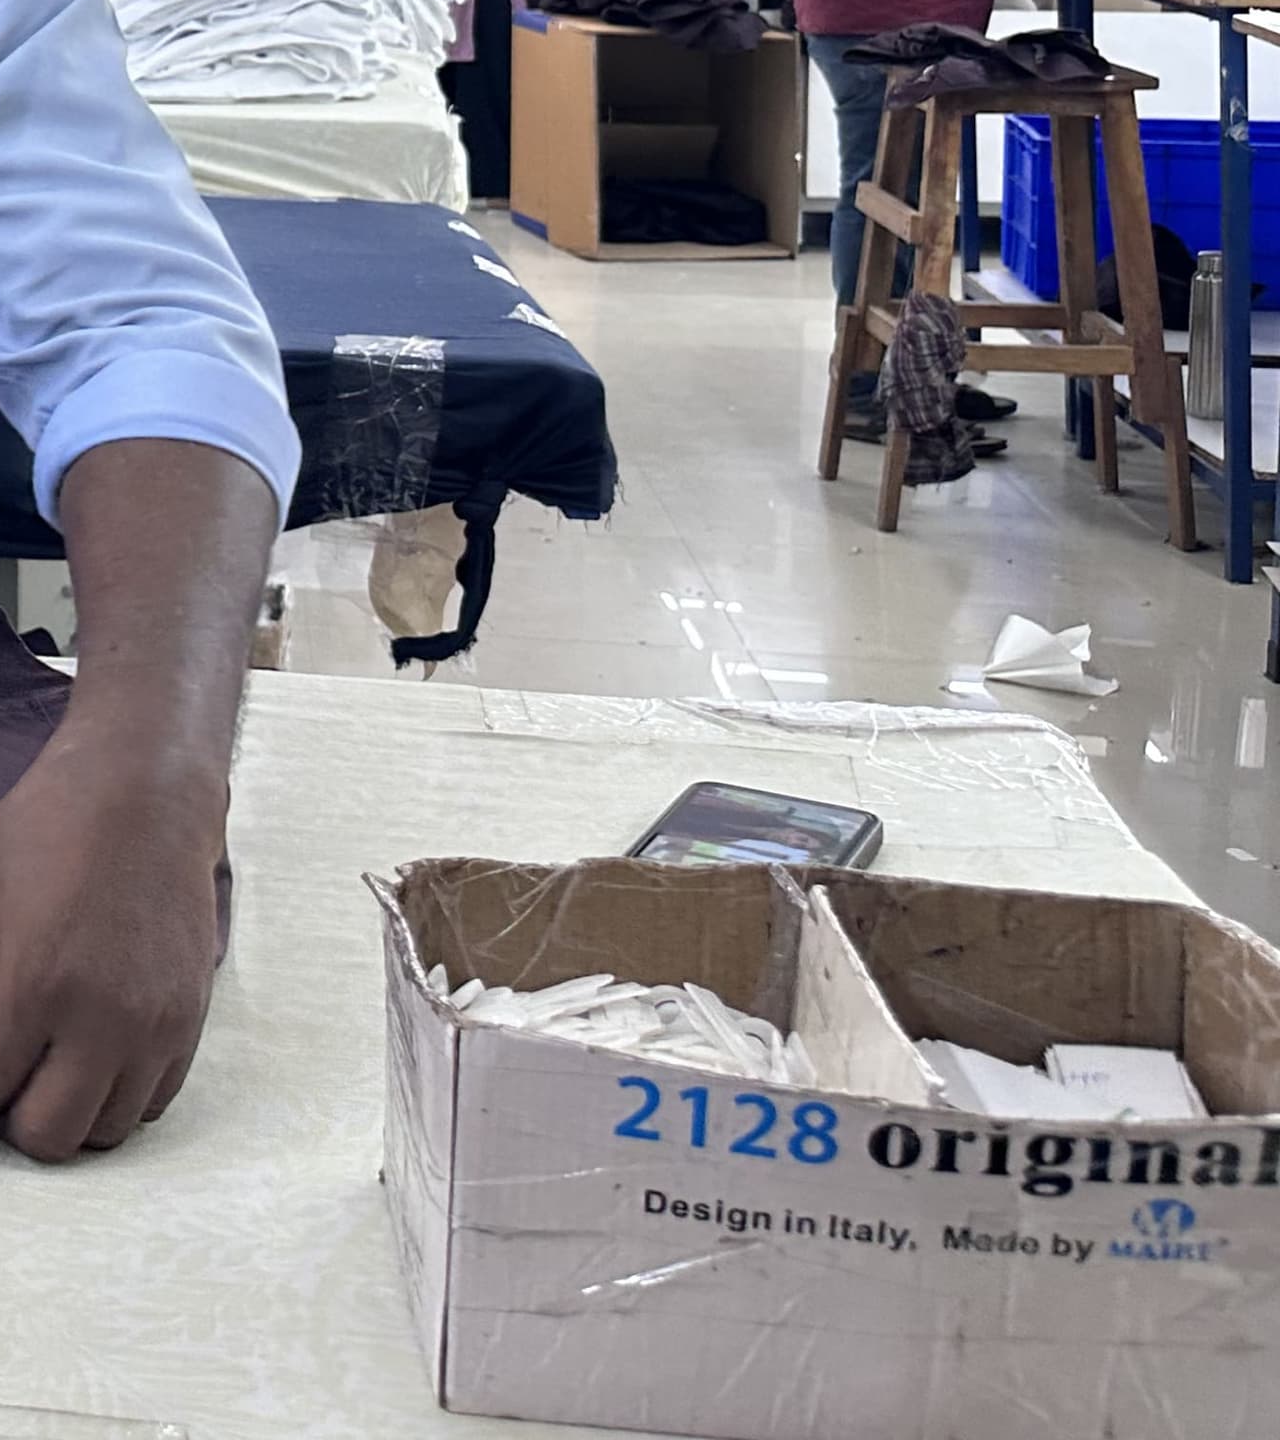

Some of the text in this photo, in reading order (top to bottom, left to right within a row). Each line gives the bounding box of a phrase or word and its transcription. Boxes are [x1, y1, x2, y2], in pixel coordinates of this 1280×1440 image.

[614, 1075, 1280, 1197] 2128 original
[644, 1188, 772, 1232] Design
[784, 1209, 817, 1237] in
[942, 1225, 1040, 1256] Made
[1050, 1233, 1095, 1263] by
